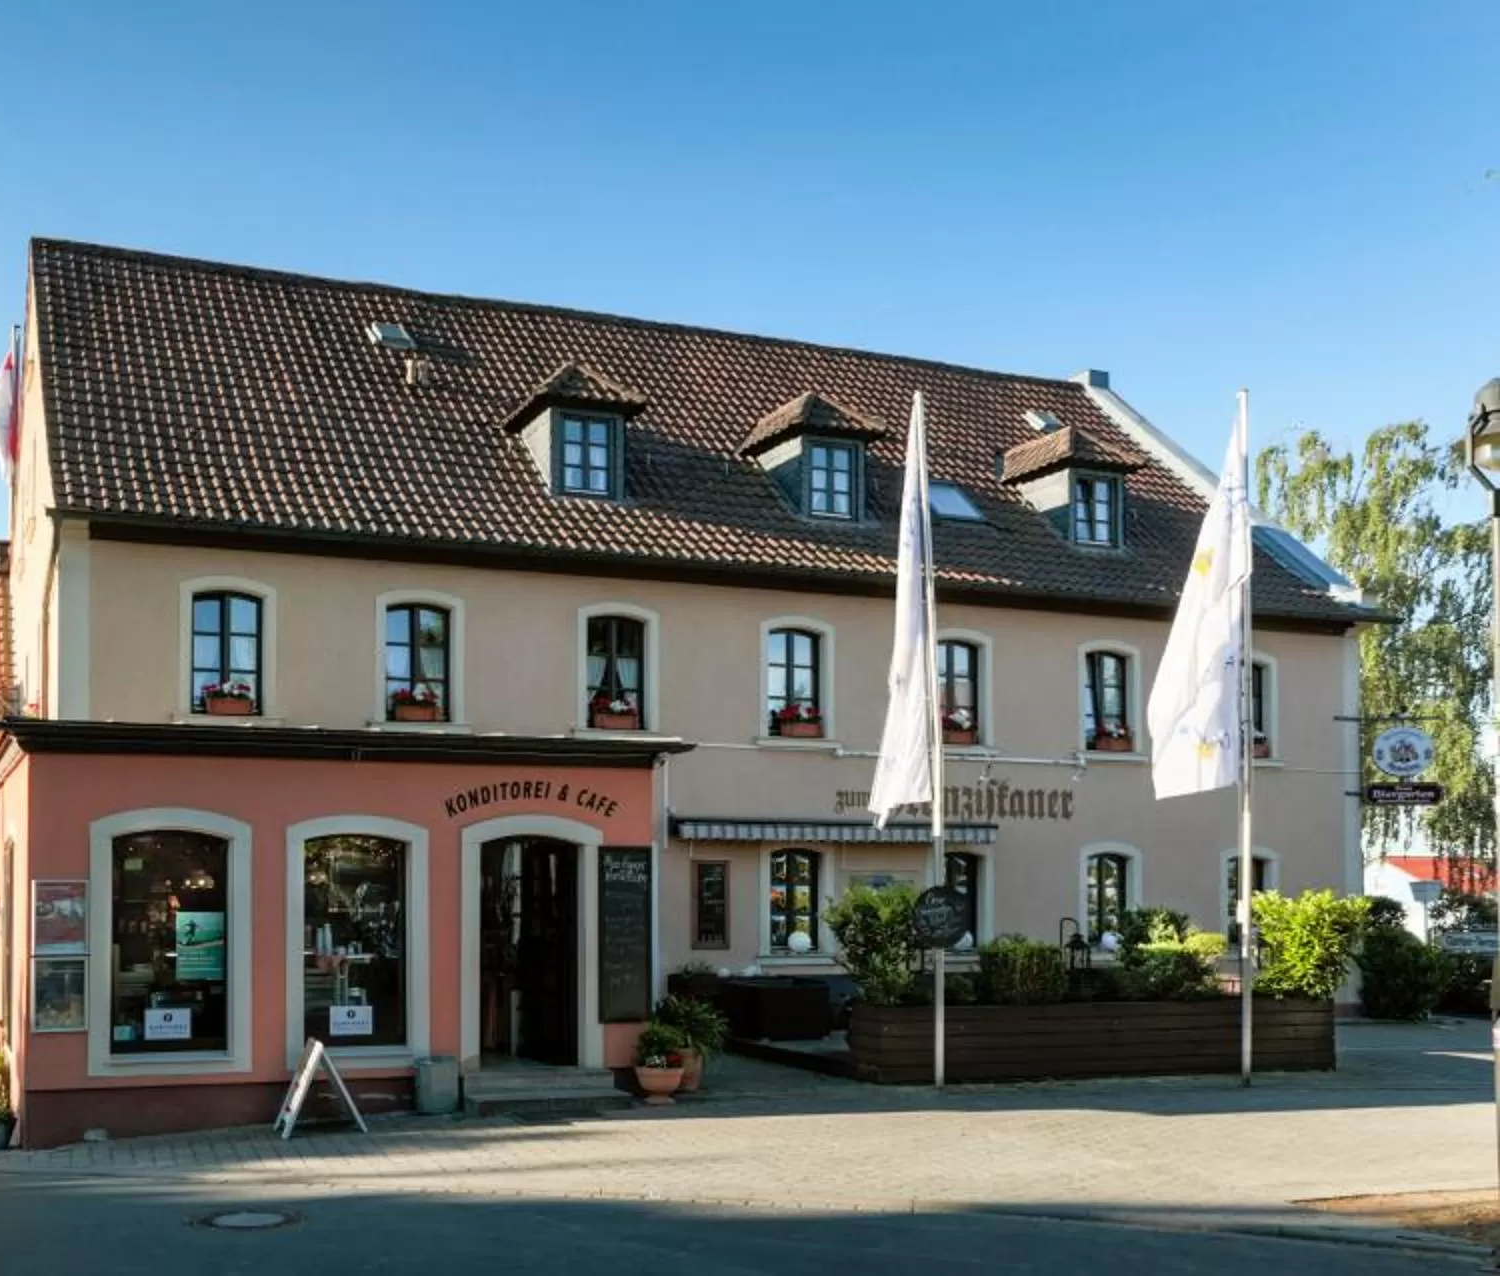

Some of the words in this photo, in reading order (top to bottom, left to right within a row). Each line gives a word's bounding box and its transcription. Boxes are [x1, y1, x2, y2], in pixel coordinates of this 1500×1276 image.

[444, 781, 551, 817] KONDITOREI
[557, 784, 570, 802] &
[577, 788, 618, 817] CAFE
